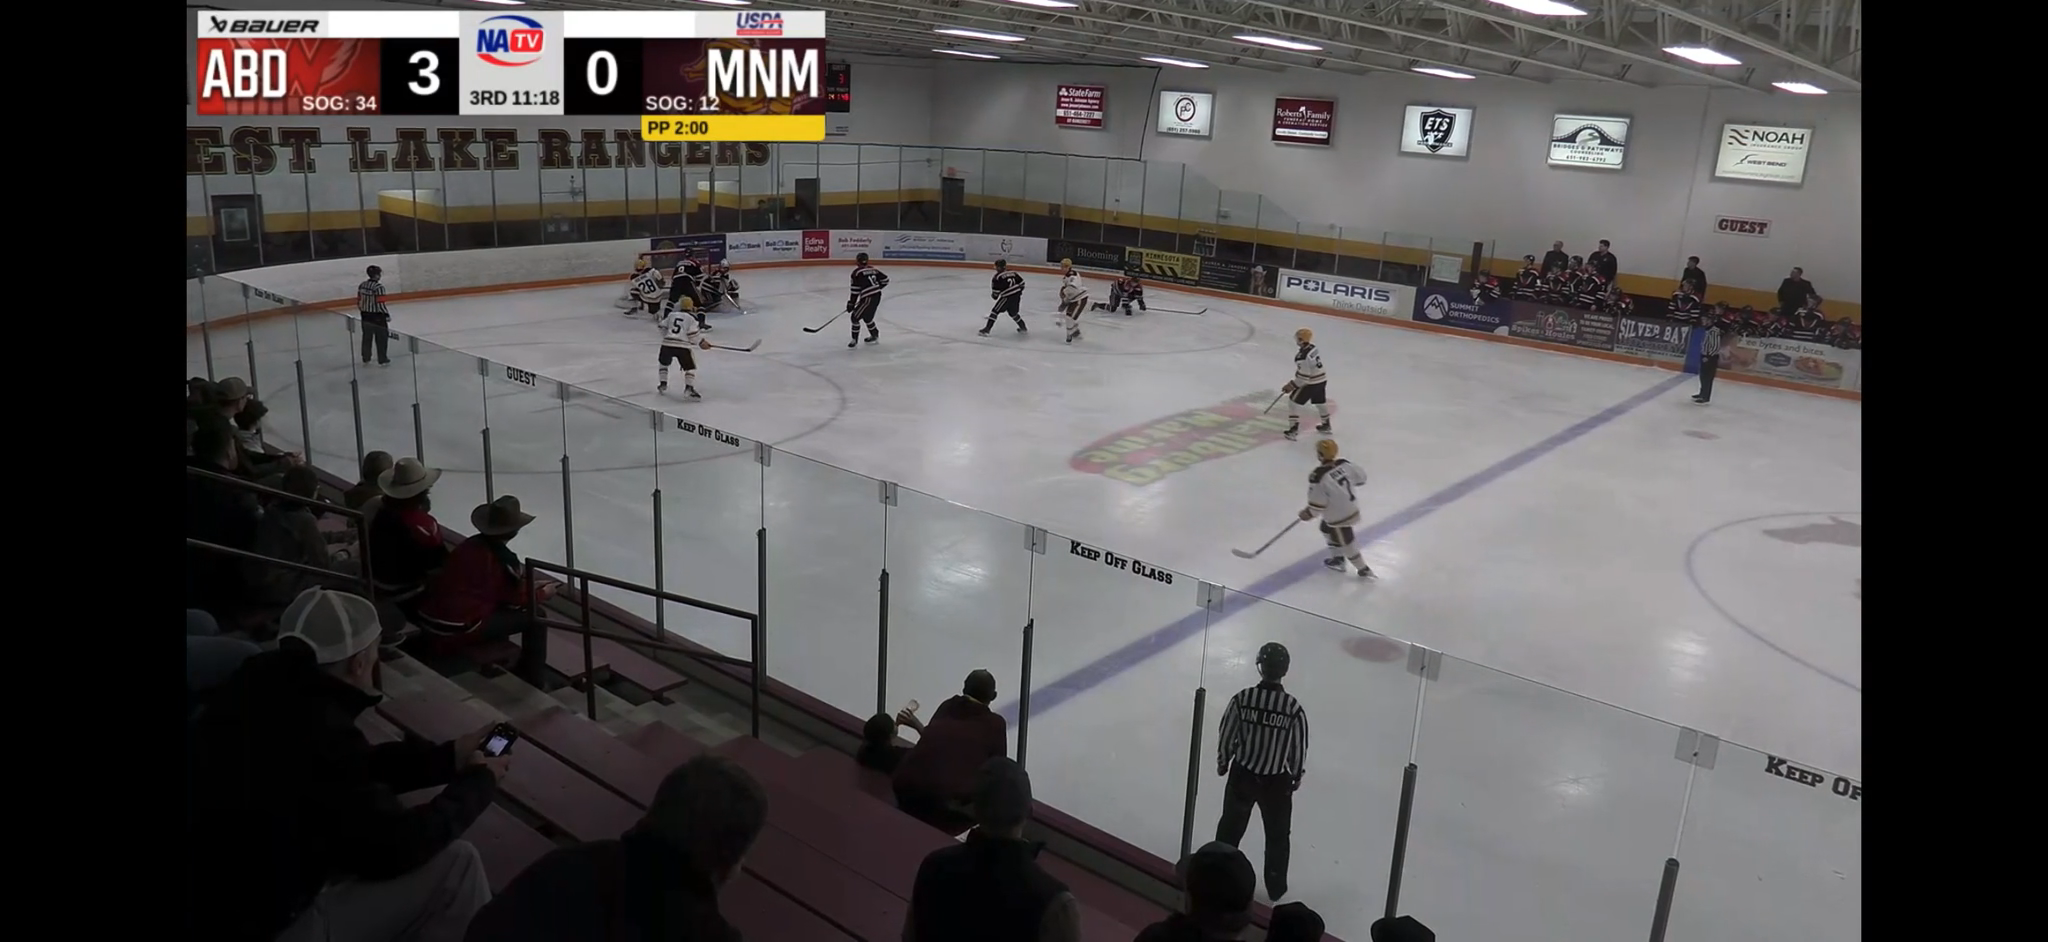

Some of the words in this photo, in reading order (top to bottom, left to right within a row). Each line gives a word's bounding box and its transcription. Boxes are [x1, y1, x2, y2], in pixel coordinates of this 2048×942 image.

[1276, 108, 1303, 118] Roberts
[1306, 110, 1331, 121] Family
[1424, 117, 1450, 131] ETS
[1752, 130, 1806, 145] NOAH
[347, 127, 520, 172] LAKE
[538, 128, 771, 170] RANGERS
[1587, 146, 1624, 154] PATHWAYS
[1718, 218, 1768, 235] GUEST
[804, 237, 825, 245] Edina
[804, 244, 828, 253] Realty
[1077, 248, 1119, 263] Blooming
[1146, 252, 1180, 262] MINNESOTA
[638, 278, 657, 295] 28
[1286, 276, 1391, 303] POLARIS
[1332, 299, 1354, 310] Think
[1355, 302, 1389, 315] Outside
[1450, 302, 1480, 312] SUMMIT
[1448, 310, 1500, 324] ORTHOPEDICS
[671, 317, 684, 334] 5
[1618, 317, 1660, 340] SILVER
[1662, 326, 1689, 345] BAY
[1760, 340, 1783, 351] bytes
[1784, 344, 1802, 354] and
[506, 366, 537, 387] GUEST
[1240, 708, 1259, 723] VAN
[1262, 711, 1292, 730] LOON
